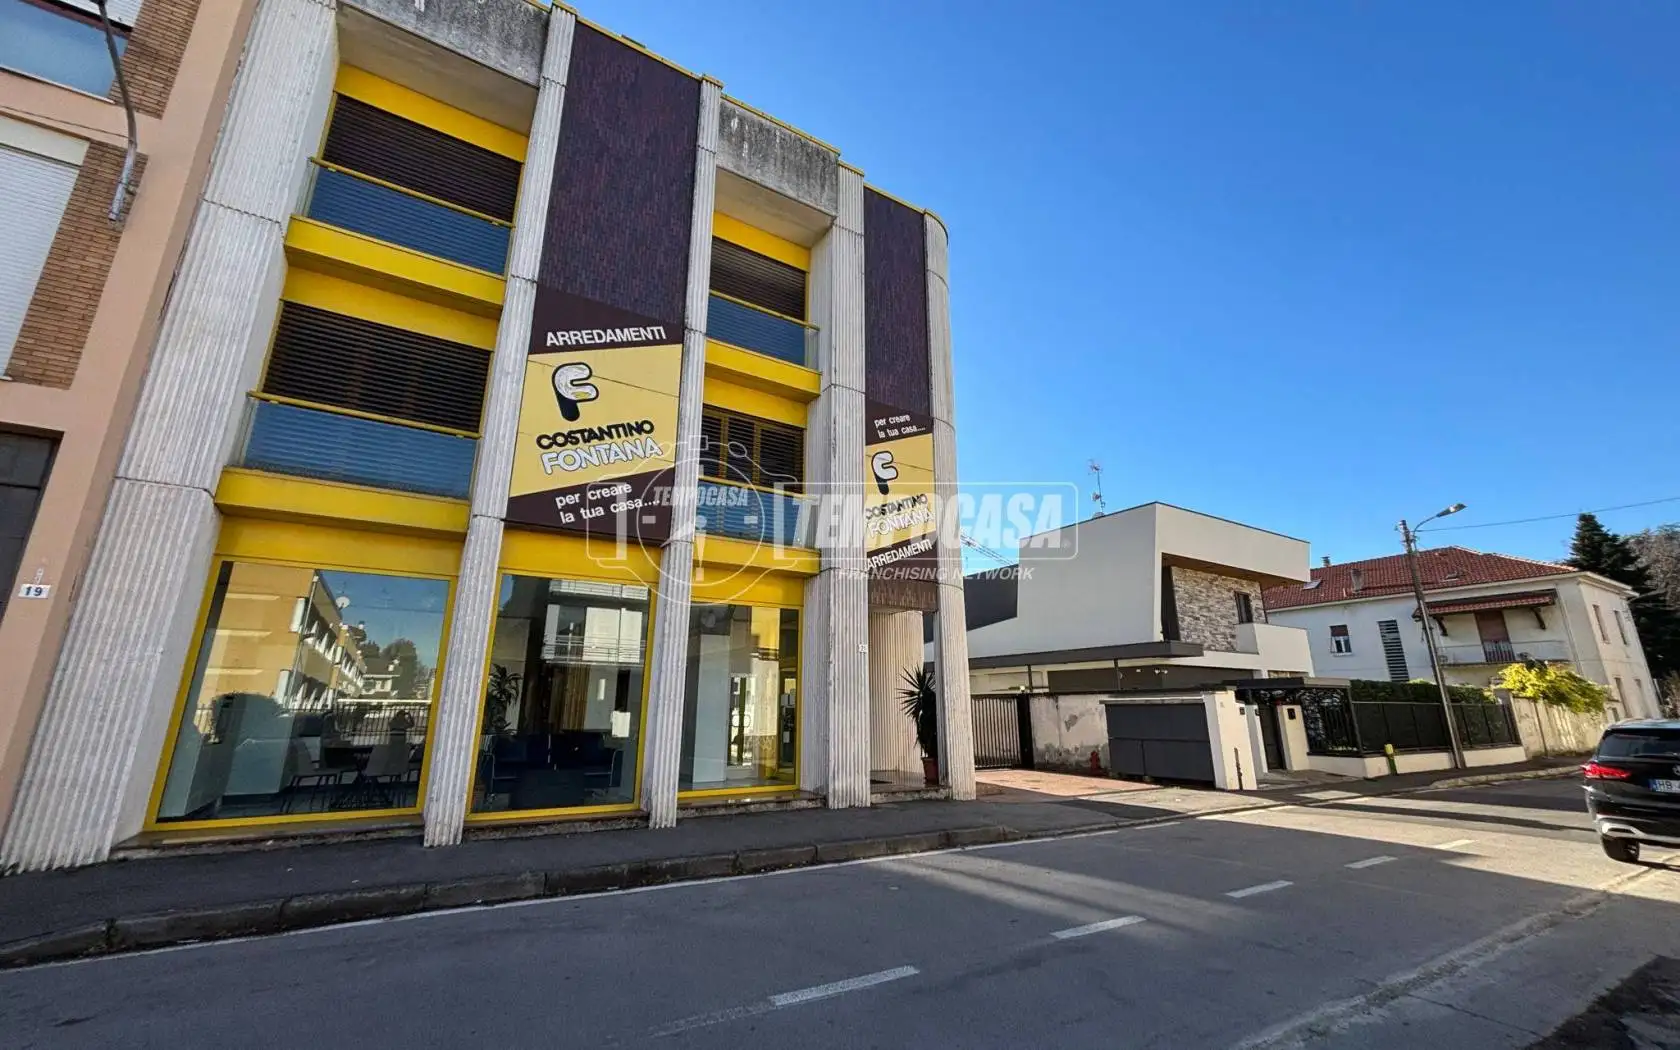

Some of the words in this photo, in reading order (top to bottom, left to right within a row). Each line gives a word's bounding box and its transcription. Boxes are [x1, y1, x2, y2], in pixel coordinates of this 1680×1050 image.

[546, 325, 667, 347] ARREDAMENTI
[535, 419, 655, 450] COSTANTINO
[873, 417, 887, 429] per
[888, 413, 911, 425] creare
[877, 429, 886, 439] la
[886, 428, 900, 437] tua
[540, 436, 664, 475] FONTANA
[555, 492, 581, 510] per
[587, 483, 633, 501] creare
[865, 493, 929, 520] COSTANTINO
[559, 511, 576, 525] la
[580, 505, 605, 520] tua
[867, 506, 936, 539] FONTANA
[864, 538, 934, 572] ARREDAMENTI
[25, 586, 43, 597] 19
